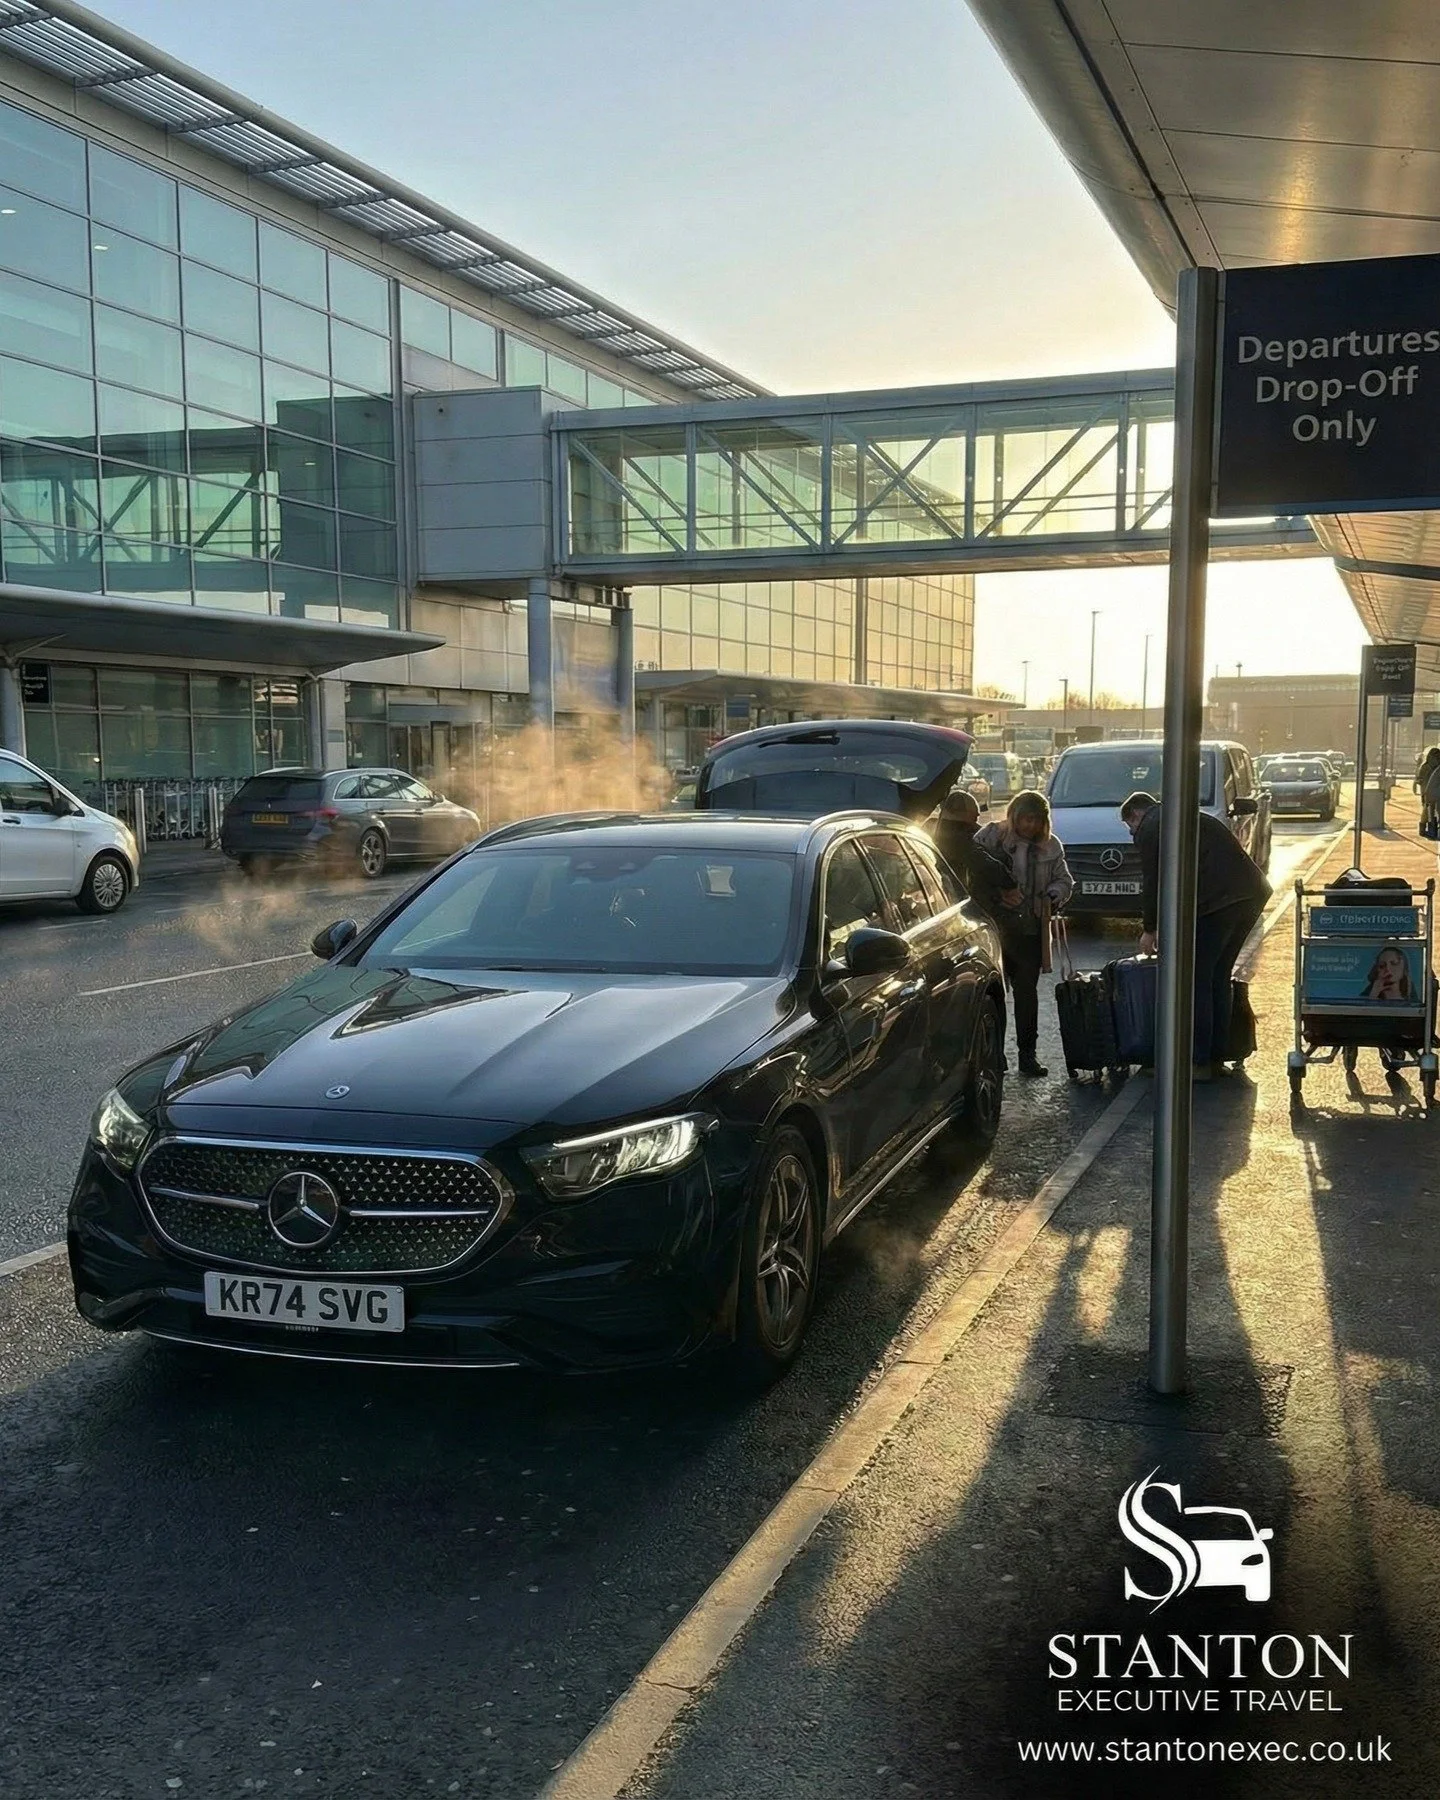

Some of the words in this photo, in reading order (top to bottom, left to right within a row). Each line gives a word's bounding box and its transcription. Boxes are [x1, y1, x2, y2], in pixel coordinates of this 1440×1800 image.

[1238, 331, 1440, 368] Departures
[1256, 365, 1419, 406] Drop-Off
[1292, 410, 1377, 447] Only
[219, 1278, 306, 1318] KR74
[318, 1287, 388, 1324] SVG
